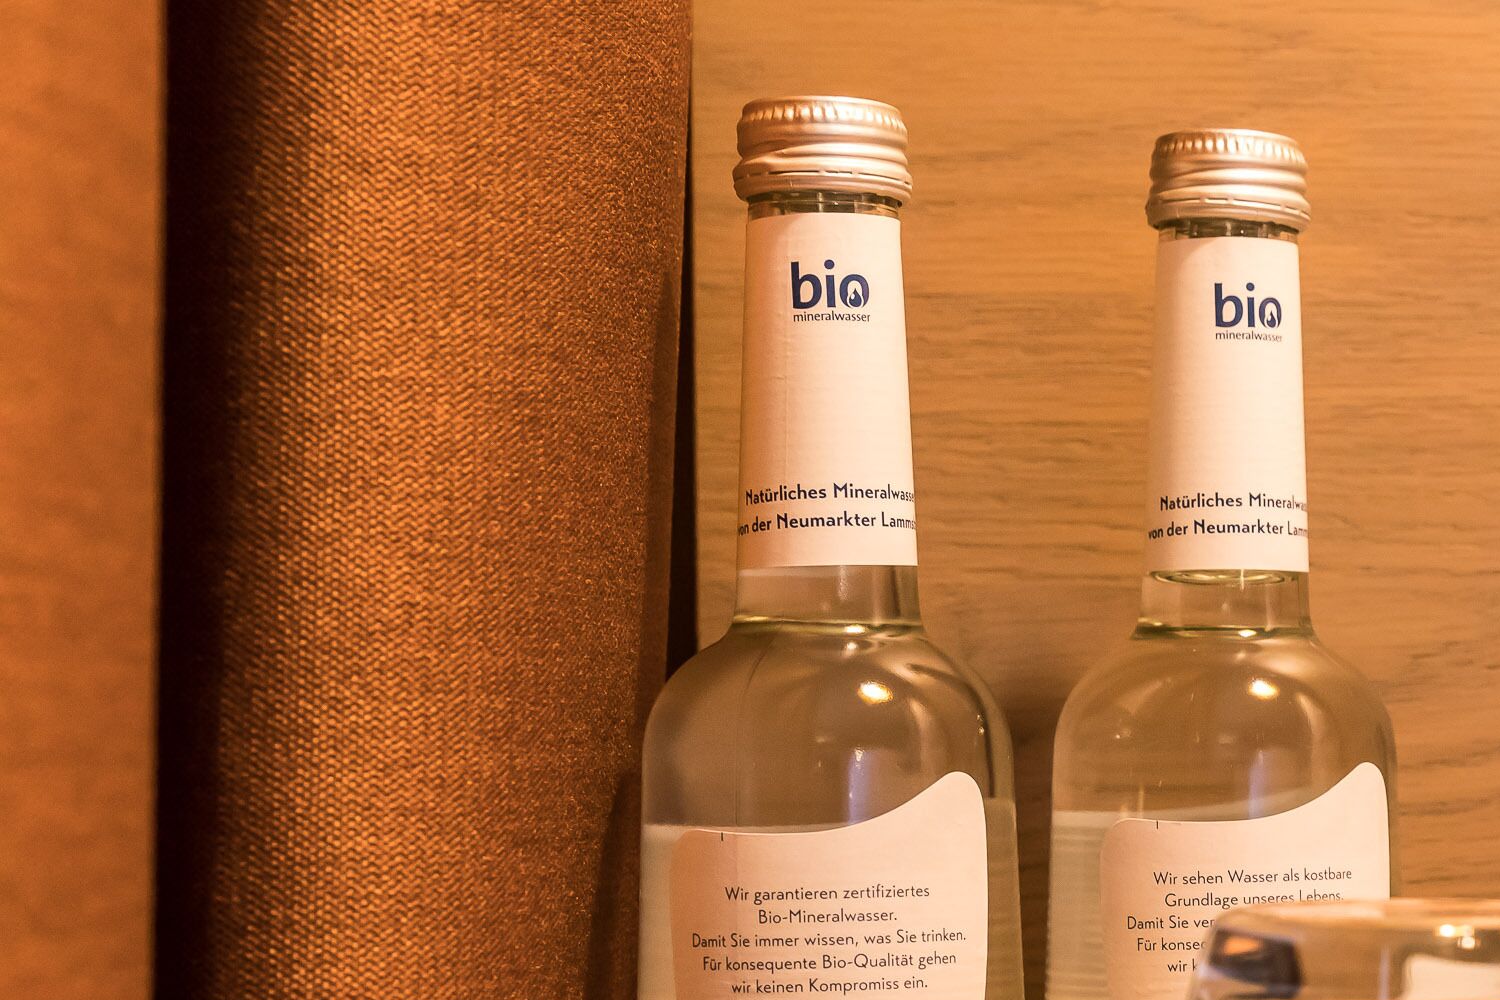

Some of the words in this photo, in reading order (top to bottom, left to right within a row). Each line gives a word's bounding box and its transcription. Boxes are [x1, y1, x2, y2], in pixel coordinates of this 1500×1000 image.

[790, 259, 870, 310] bio
[1214, 282, 1282, 328] bio
[793, 311, 871, 322] mineralwasser
[1215, 330, 1282, 342] mineralwasser
[745, 483, 827, 506] Natürliches
[1160, 492, 1243, 511] Natürliches
[752, 515, 772, 533] der
[777, 511, 876, 529] Neumarkter
[1167, 521, 1188, 537] der
[1193, 519, 1284, 535] Neumarkter
[1153, 871, 1178, 885] Wir
[1182, 871, 1223, 885] sehen
[1227, 869, 1277, 883] Wasser
[1283, 868, 1300, 882] als
[1304, 867, 1352, 881] kostbare
[725, 886, 749, 901] Wir
[753, 887, 838, 905] garantieren
[843, 884, 930, 899] zertifiziertes
[1164, 892, 1238, 910] Grundlage
[1243, 894, 1295, 904] unseres
[758, 908, 898, 924] Bio-Mineralwasser.
[1127, 915, 1164, 930] Damit
[1169, 915, 1189, 928] Sie
[692, 932, 726, 948] Damit
[730, 932, 750, 948] Sie
[755, 934, 799, 947] immer
[804, 933, 859, 947] wissen,
[864, 933, 892, 945] was
[896, 929, 917, 944] Sie
[921, 928, 967, 942] trinken.
[1137, 937, 1157, 951] Für
[703, 956, 722, 971] Für
[725, 954, 817, 974] konsequente
[822, 952, 913, 969] Bio-Qualität
[918, 951, 956, 970] gehen
[1167, 960, 1187, 972] wir
[731, 979, 751, 993] wir
[756, 978, 803, 993] keinen
[809, 976, 899, 995] Kompromiss
[904, 976, 928, 989] ein.
